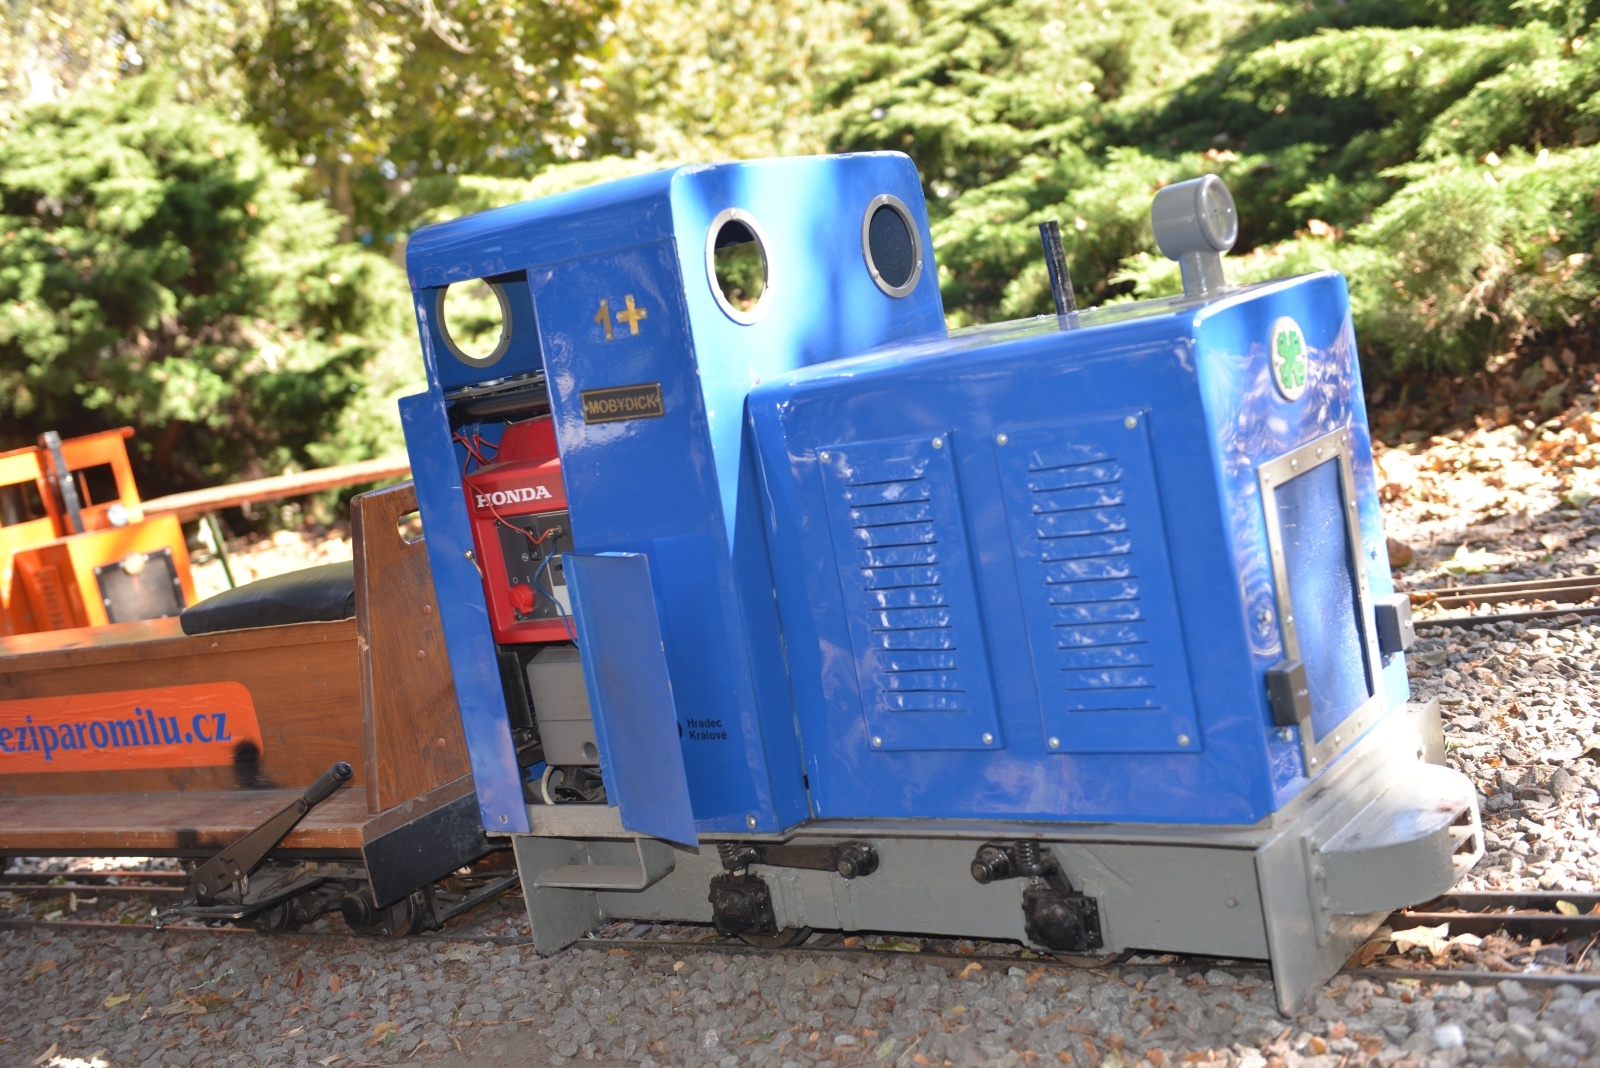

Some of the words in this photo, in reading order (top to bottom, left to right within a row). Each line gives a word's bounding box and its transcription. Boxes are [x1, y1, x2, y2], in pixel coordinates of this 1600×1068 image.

[588, 394, 657, 414] MOBYDICK
[475, 485, 552, 508] HONDA
[686, 718, 723, 728] Hradec
[689, 730, 728, 740] Králové
